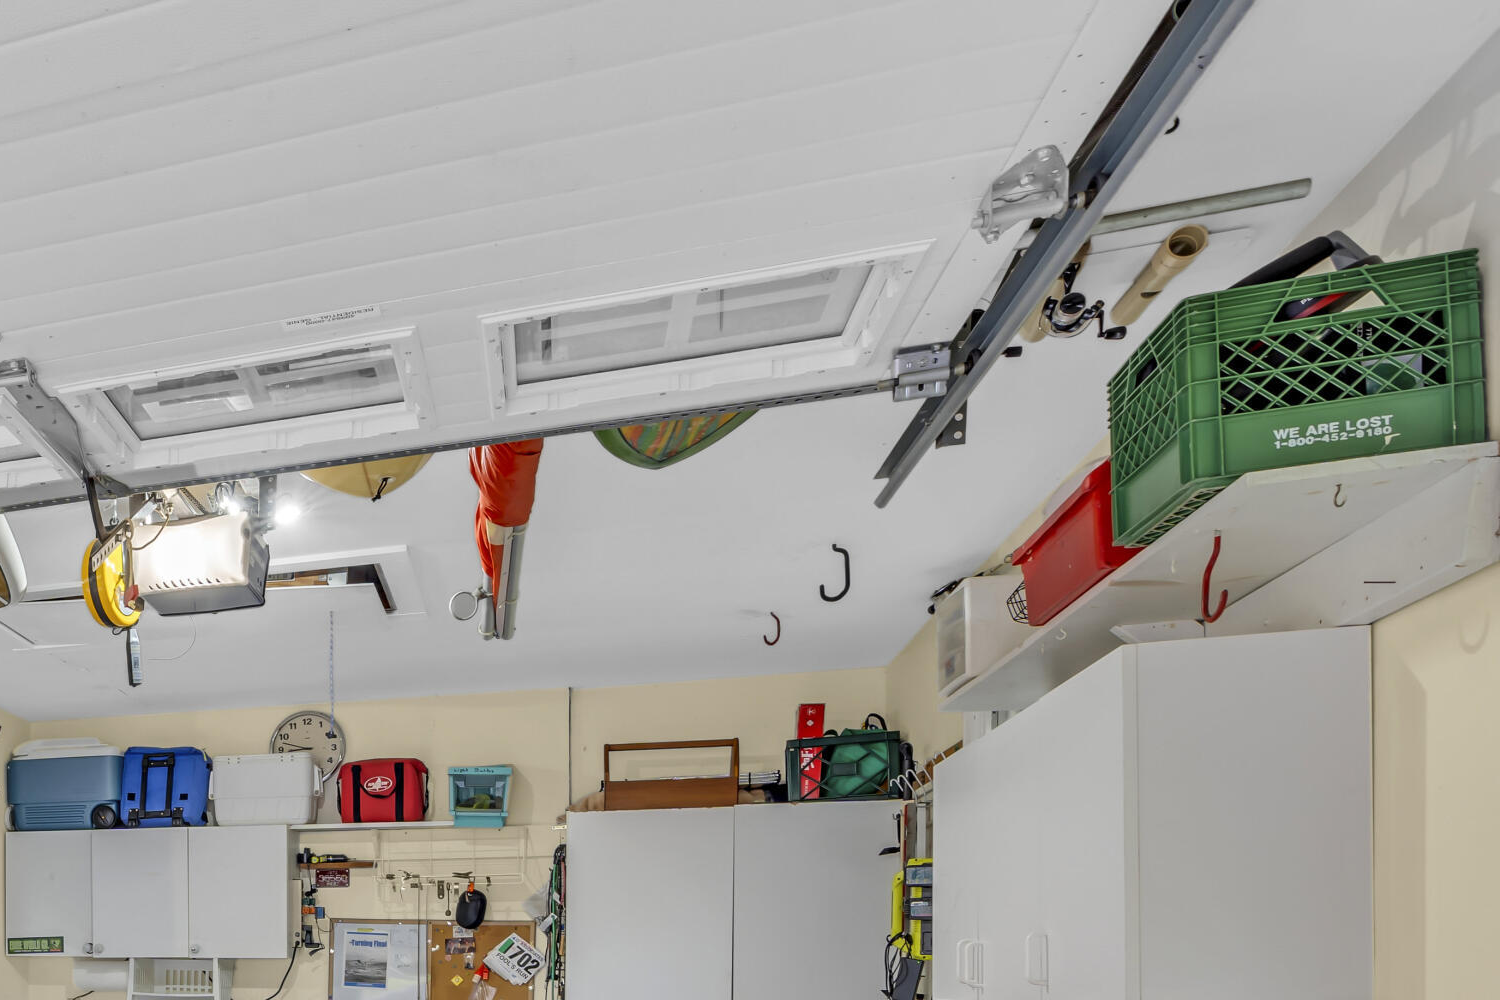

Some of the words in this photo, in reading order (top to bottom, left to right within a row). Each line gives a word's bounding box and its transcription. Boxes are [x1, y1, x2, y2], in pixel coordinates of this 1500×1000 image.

[1273, 427, 1300, 440] WE
[1306, 422, 1340, 436] ARE
[1345, 414, 1394, 431] LOST
[289, 722, 297, 730] 11
[302, 718, 312, 726] 12
[279, 733, 289, 741] 10
[495, 952, 516, 970] FOOL'S
[515, 967, 529, 980] RUN
